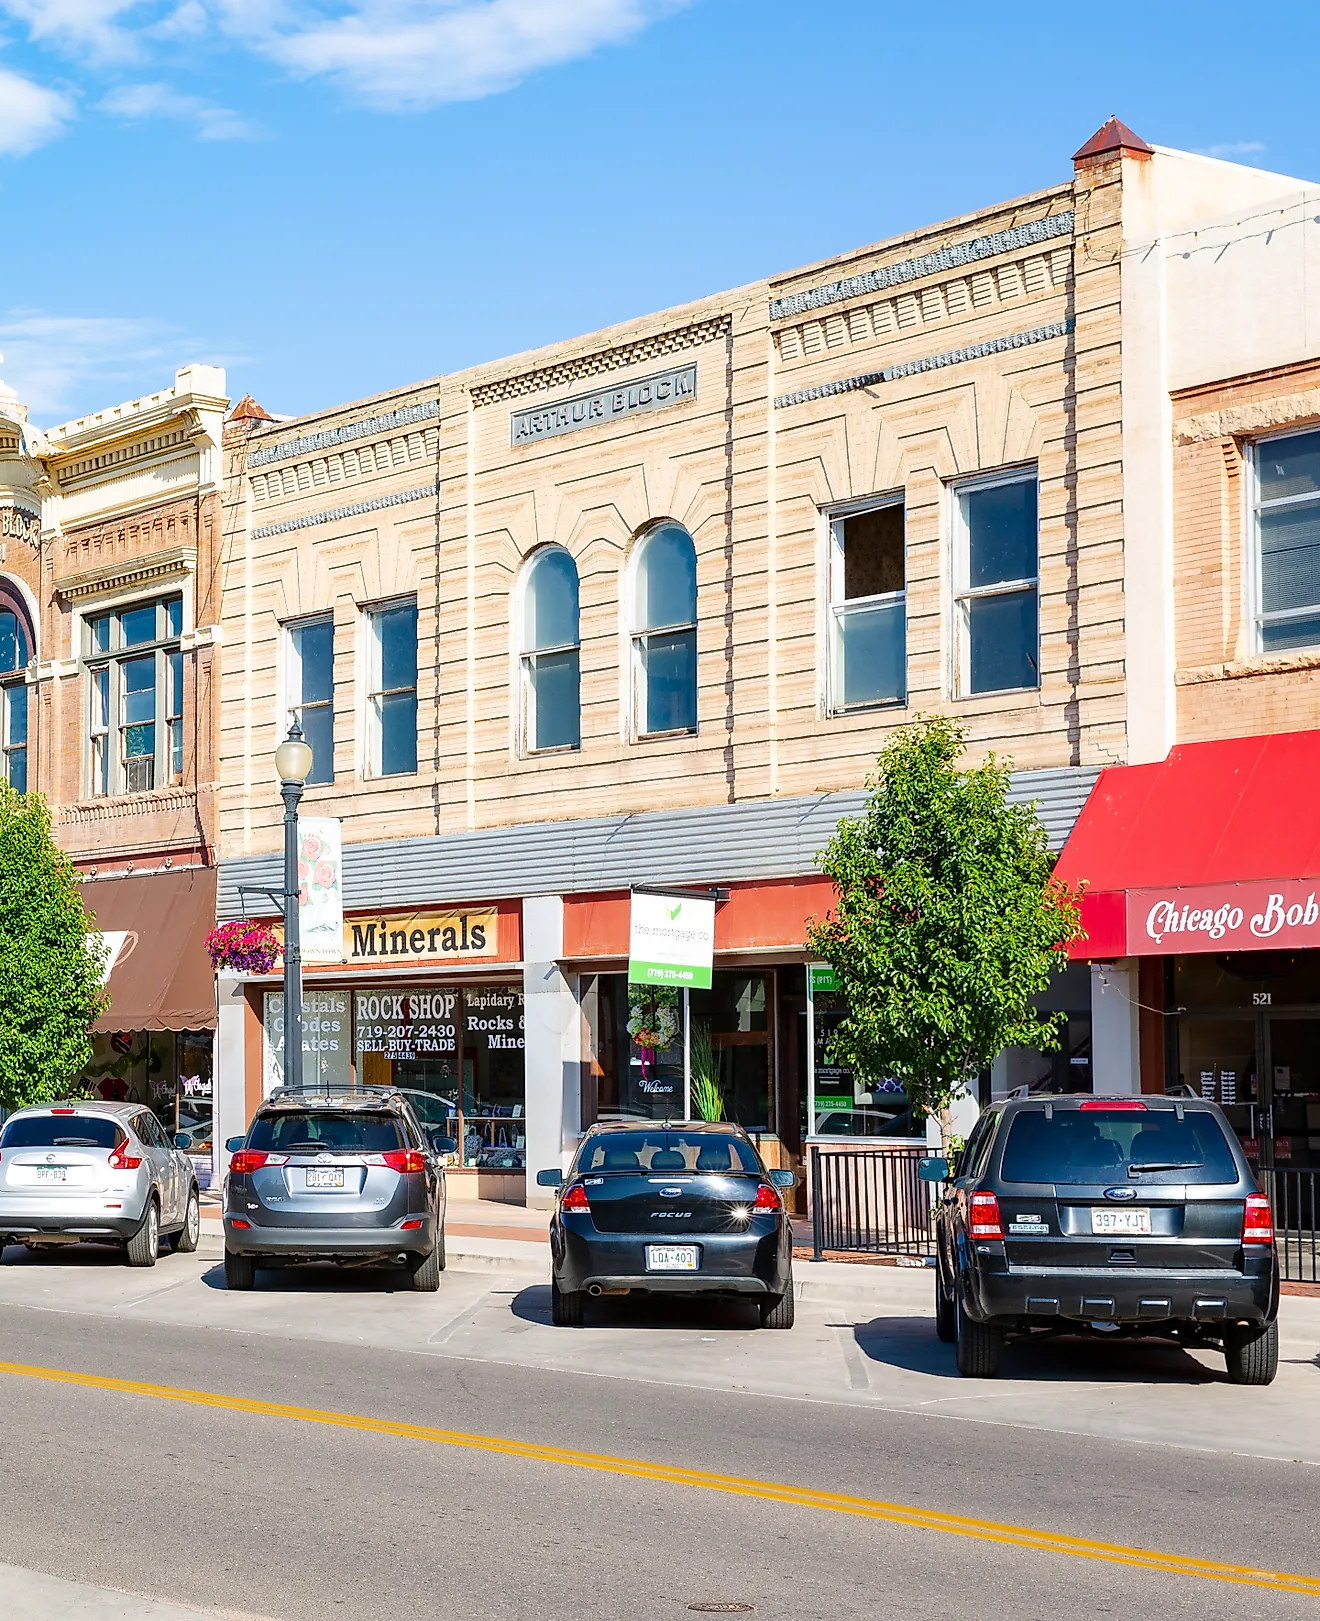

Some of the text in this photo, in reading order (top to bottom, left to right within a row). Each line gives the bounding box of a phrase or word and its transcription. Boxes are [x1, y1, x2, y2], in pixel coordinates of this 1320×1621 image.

[516, 373, 693, 439] ARTHUR BLOCK
[2, 512, 40, 550] BLOCK
[1146, 900, 1244, 944] Chicago
[352, 915, 486, 957] Minerals
[652, 928, 696, 942] mortgage
[268, 997, 347, 1014] Cstals
[356, 993, 456, 1021] ROCK SHOP
[467, 992, 515, 1011] Lapidary
[1252, 992, 1272, 1005] 521
[273, 1016, 341, 1032] Godes
[467, 1014, 514, 1031] Rocks
[357, 1025, 456, 1038] 719-207-2430
[275, 1036, 340, 1051] Aates
[357, 1038, 456, 1052] SELL-BUY-TRADE
[639, 1080, 673, 1093] Welcome
